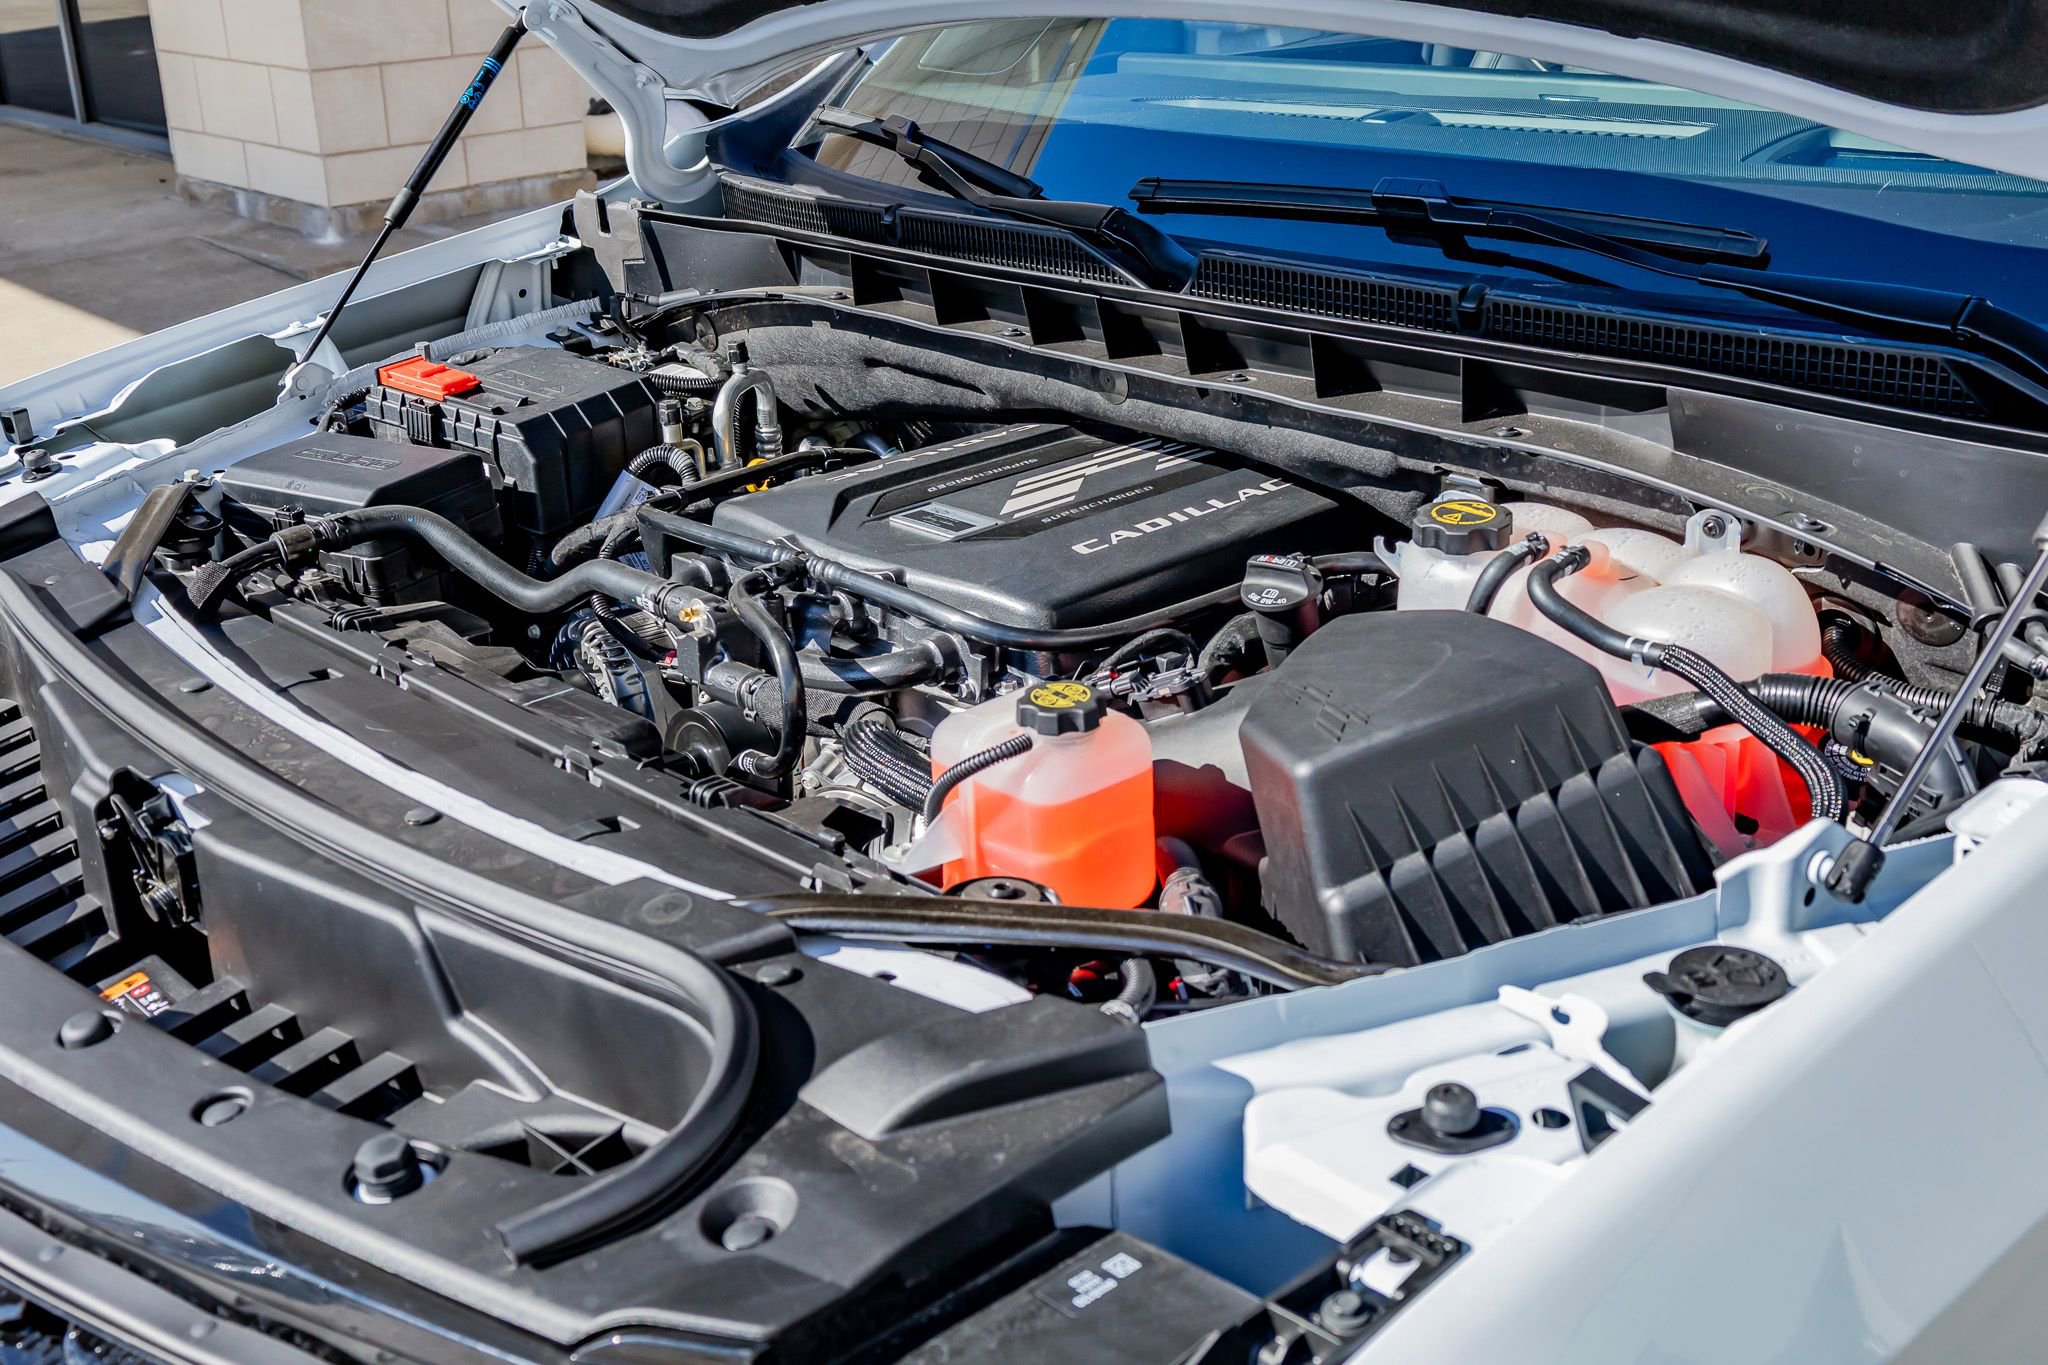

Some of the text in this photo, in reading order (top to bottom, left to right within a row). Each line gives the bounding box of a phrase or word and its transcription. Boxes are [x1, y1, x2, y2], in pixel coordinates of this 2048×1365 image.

[927, 457, 1039, 493] SUPERCHARGED
[1040, 485, 1154, 524] SUPERCHARGED
[1071, 477, 1294, 555] CADILLAC
[1256, 555, 1284, 565] Mobil
[1247, 592, 1287, 605] SAE 0W-40
